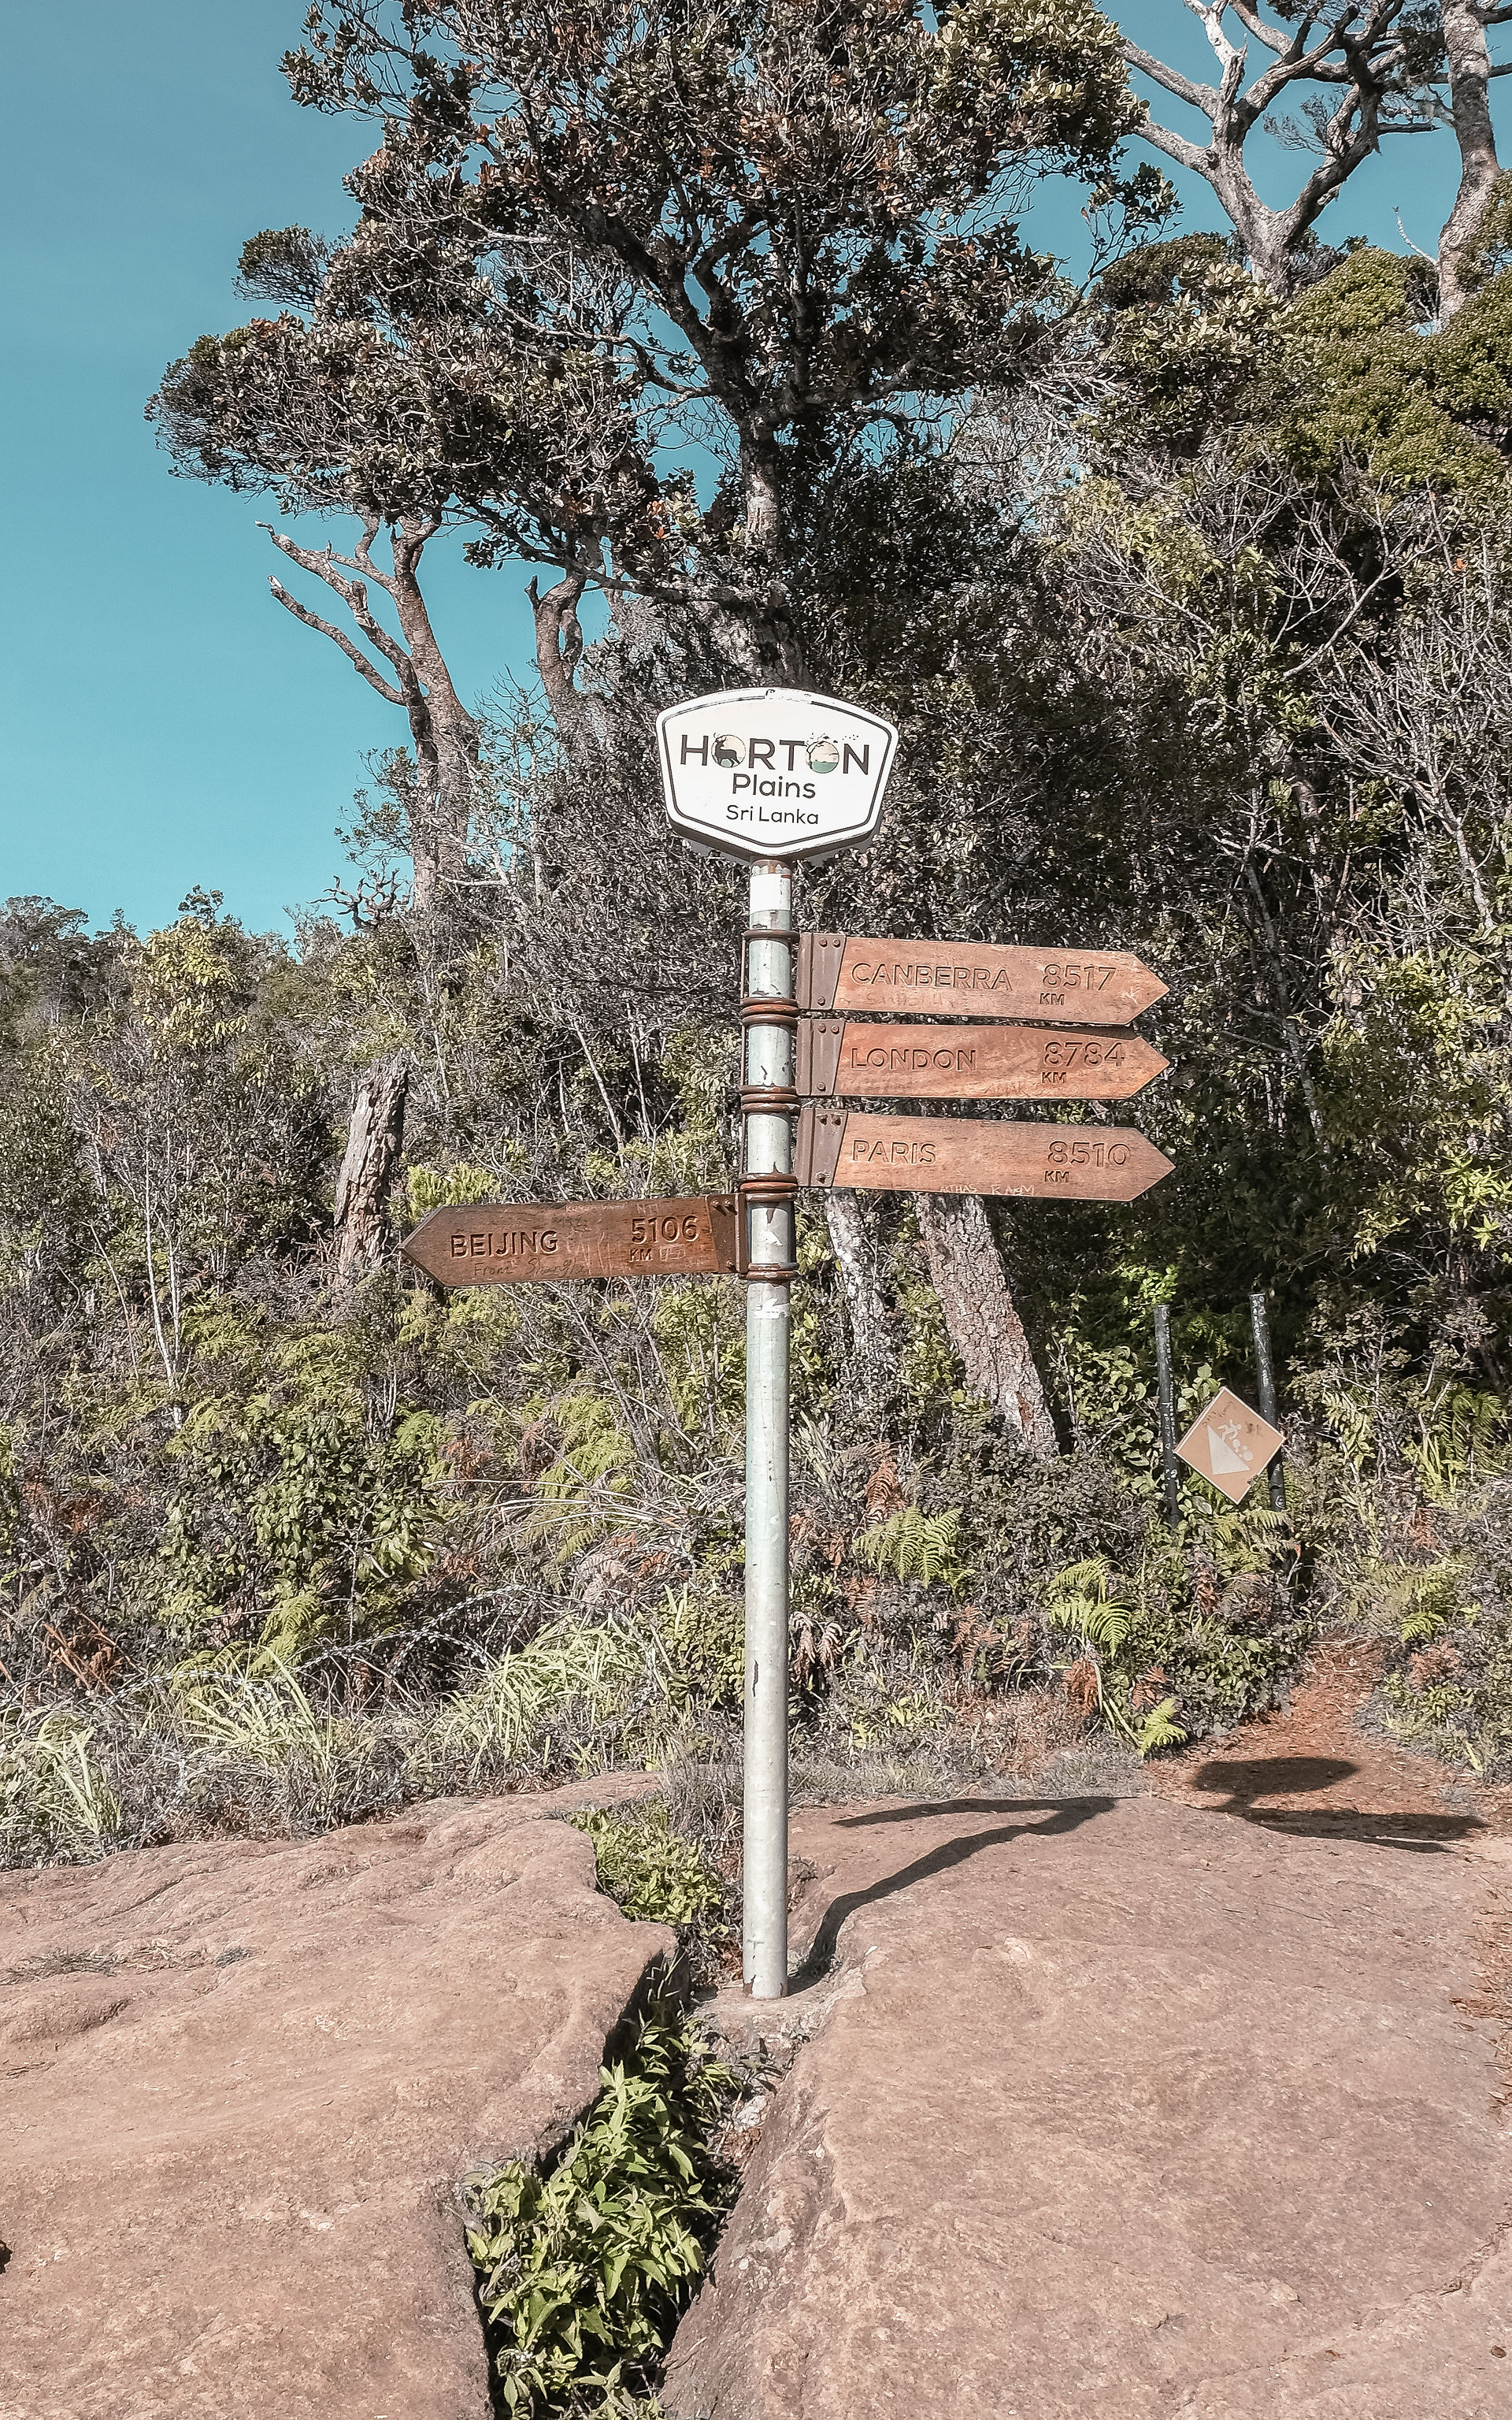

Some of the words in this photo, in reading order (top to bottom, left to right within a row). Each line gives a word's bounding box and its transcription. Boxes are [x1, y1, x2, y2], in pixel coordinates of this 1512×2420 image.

[680, 733, 870, 776] HORTON
[732, 773, 816, 799] Plains
[726, 804, 754, 822] Sri
[758, 806, 819, 825] Lanka
[850, 962, 1014, 991] CANBERRA
[1041, 963, 1117, 990] 8517
[1039, 992, 1065, 1006] KM
[850, 1047, 976, 1072] LONDON
[1043, 1041, 1126, 1068] 8784
[1041, 1071, 1067, 1085] KM
[851, 1139, 937, 1165] PARIS
[1047, 1139, 1132, 1167] 8510
[1043, 1169, 1070, 1184] KM
[450, 1229, 559, 1259] BEIJING
[631, 1214, 700, 1245] 5106
[629, 1247, 653, 1263] KM
